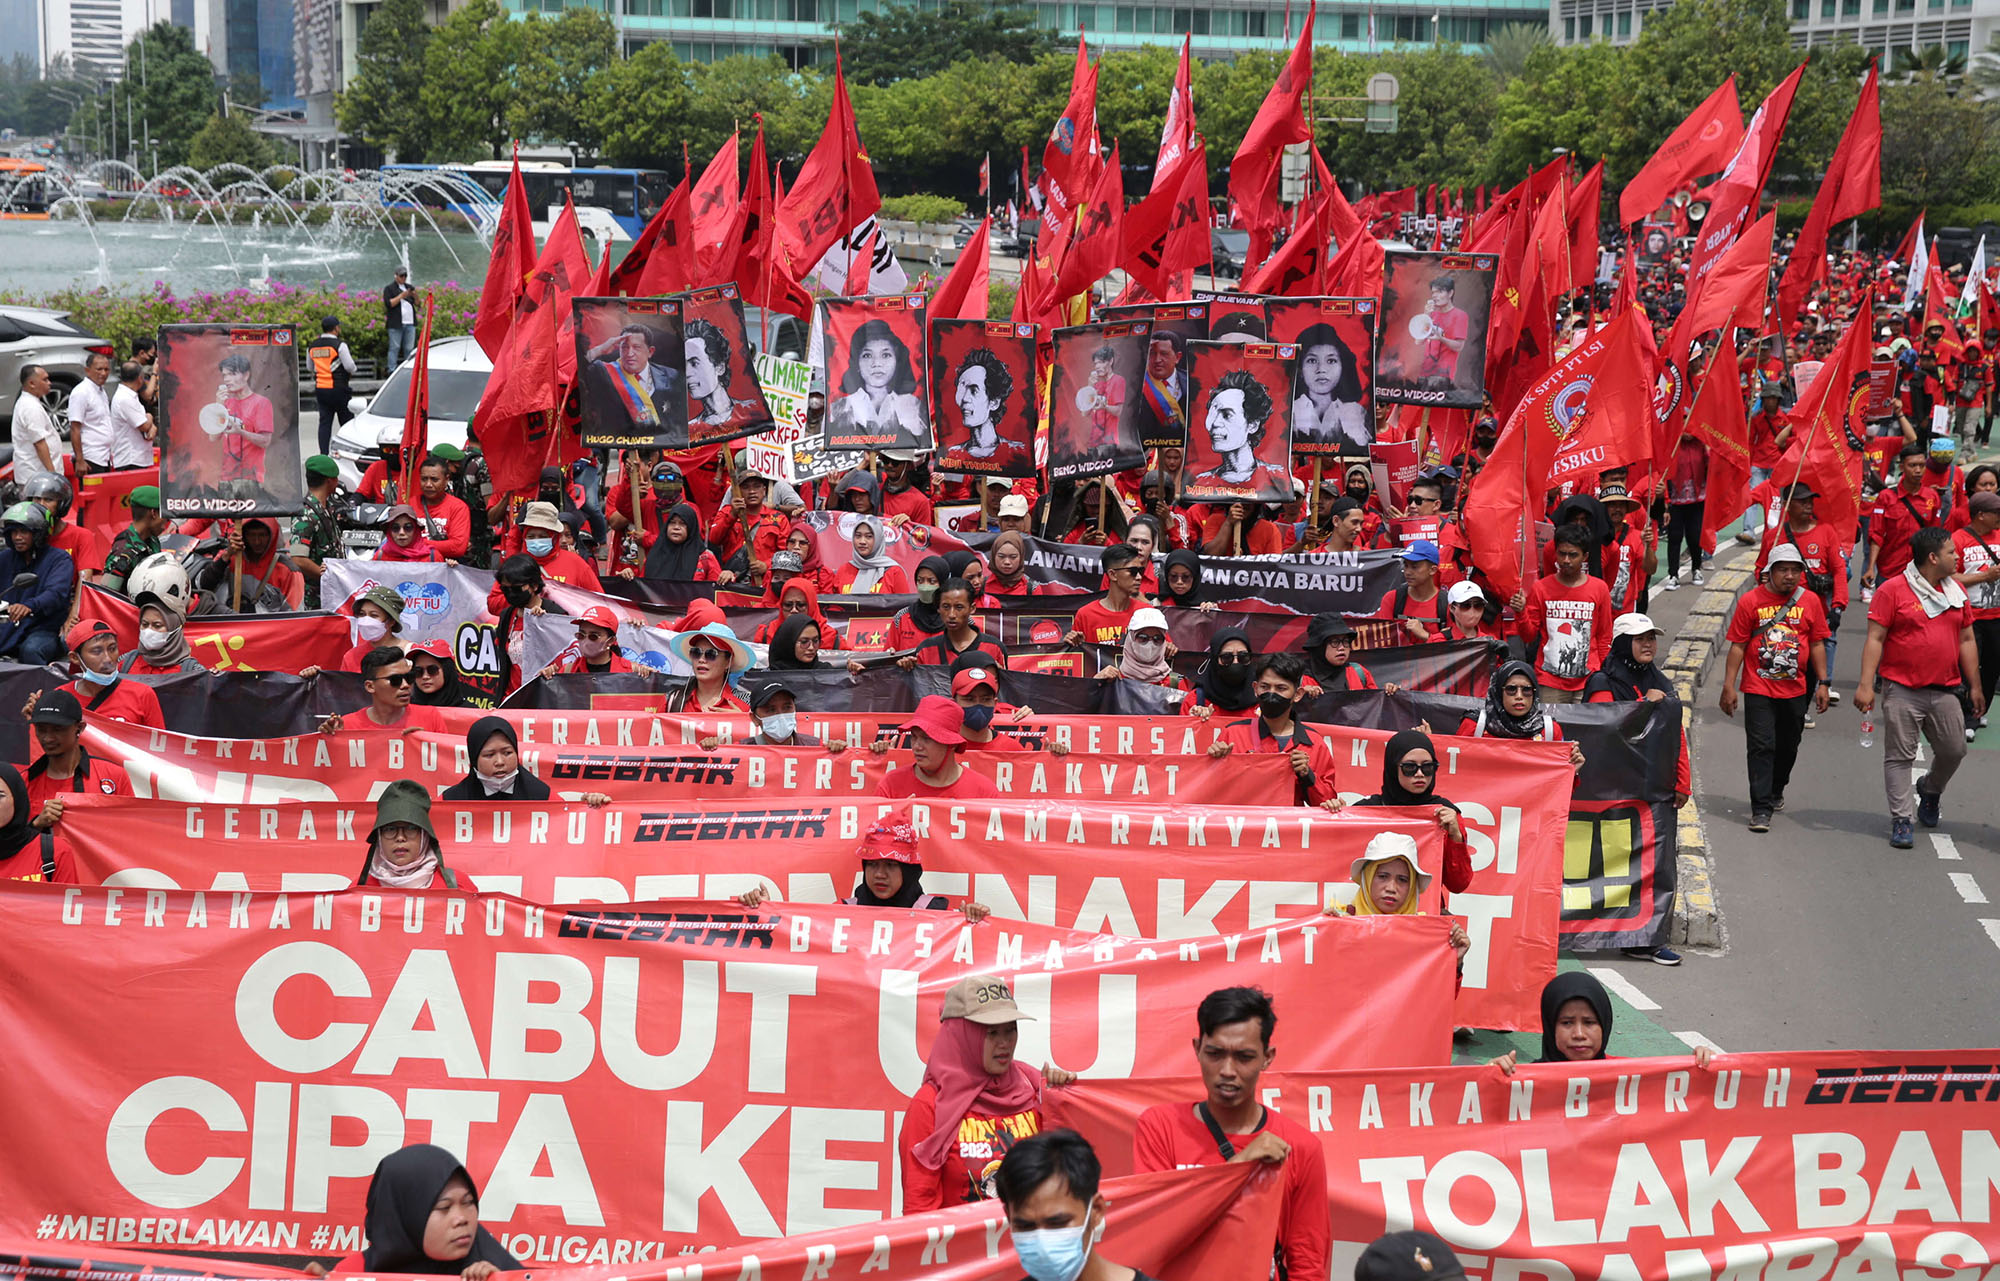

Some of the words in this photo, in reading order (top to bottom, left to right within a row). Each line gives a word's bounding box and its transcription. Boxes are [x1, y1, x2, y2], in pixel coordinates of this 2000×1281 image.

[1196, 293, 1215, 301] CHE
[757, 354, 811, 394] CLIMATE
[1535, 369, 1564, 396] SPTP
[1565, 354, 1583, 371] PT
[1582, 340, 1605, 358] LSI
[1404, 389, 1445, 401] WIDODO
[586, 434, 614, 445] HUGO
[616, 434, 655, 445] CHAVEZ
[829, 433, 897, 446] MARSINAH
[1143, 438, 1182, 447] CHAVEZ
[750, 448, 787, 477] JUSTIC
[1053, 466, 1077, 479] BENO
[1079, 458, 1114, 473] WIDODO
[166, 499, 201, 511] BENO
[203, 499, 257, 511] WIDODO
[1234, 571, 1290, 590] GAYA
[1294, 574, 1364, 593] BARU!
[403, 596, 441, 610] WFTU
[1545, 600, 1595, 610] WORKERS
[1546, 609, 1594, 620] CONTROL
[552, 754, 741, 785] GEBRAK
[633, 808, 832, 843] GEBRAK
[640, 818, 689, 826] GERAKAN
[692, 817, 727, 825] BURUH
[730, 815, 782, 823] BERSAMA
[785, 814, 829, 822] RAKYAT
[558, 911, 781, 949] GEBRAK
[668, 922, 727, 930] BERSAMA
[730, 922, 778, 930] RAKYAT
[235, 941, 818, 1094] CABUT
[1815, 1075, 1884, 1085] GERAKAN
[1887, 1074, 1938, 1082] BURUH
[106, 1074, 607, 1229] CIPTA
[960, 1142, 994, 1158] 2023
[1359, 1134, 1771, 1251] TOLAK
[36, 1213, 300, 1250] #MEIBERLAWAN
